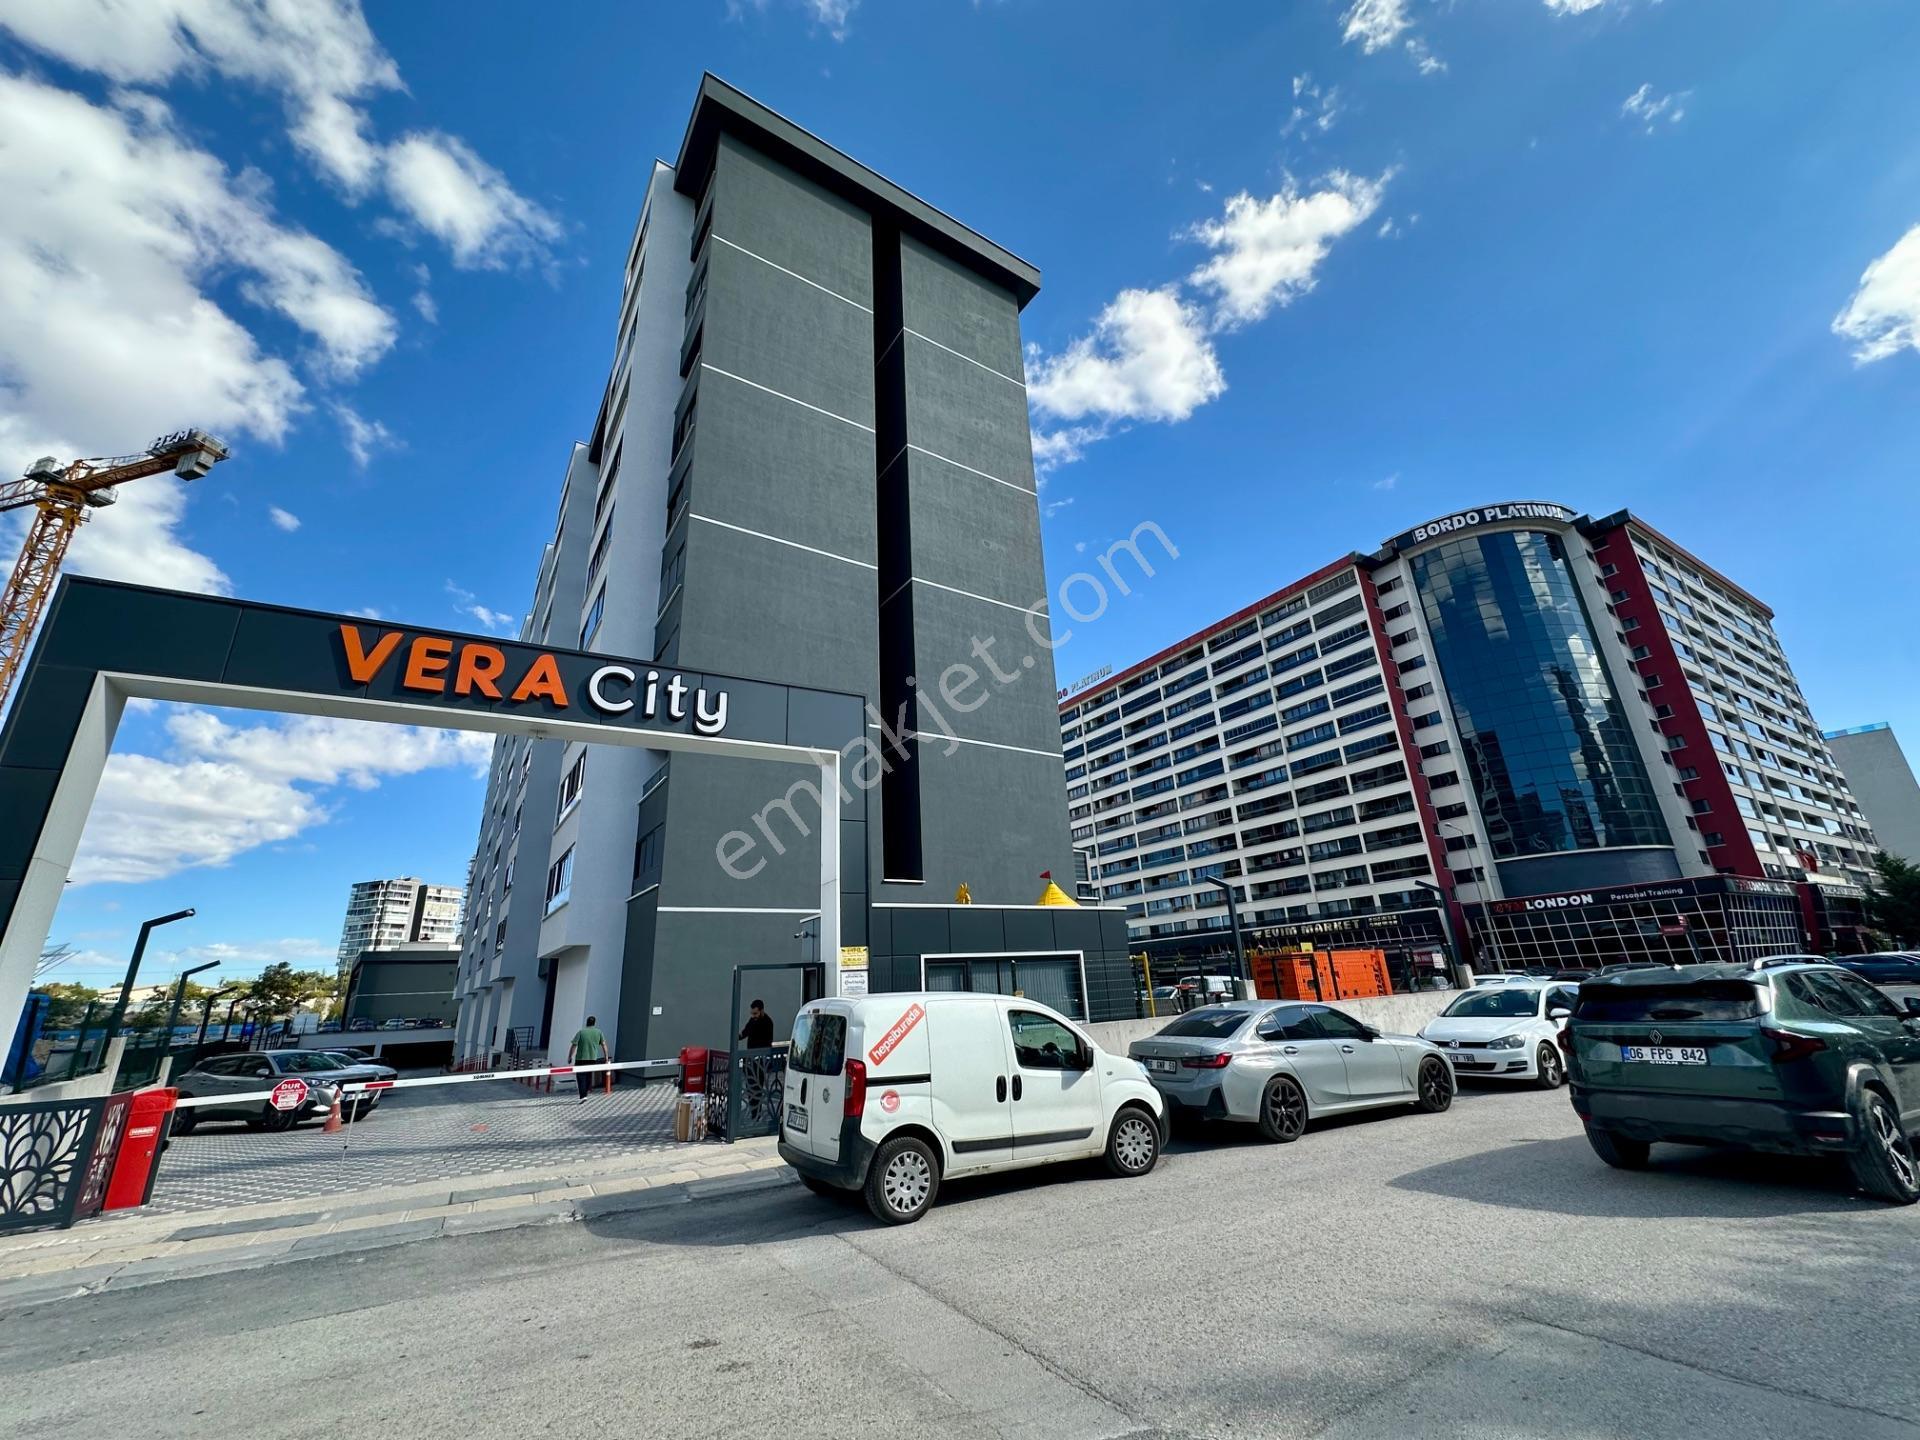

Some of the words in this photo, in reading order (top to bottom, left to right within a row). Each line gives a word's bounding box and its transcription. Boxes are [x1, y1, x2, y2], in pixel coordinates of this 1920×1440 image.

[1414, 512, 1480, 542] BORDO
[1484, 504, 1563, 521] PLATINUM
[339, 624, 568, 708] VERA
[587, 664, 730, 735] City
[1610, 891, 1647, 900] Personal
[1649, 886, 1684, 898] Training
[1525, 894, 1594, 910] LONDON
[1301, 919, 1360, 935] MARKET
[871, 1008, 921, 1060] hepsiburada
[1629, 1047, 1644, 1059] 06
[1650, 1048, 1673, 1060] FPG
[1681, 1048, 1705, 1061] 842
